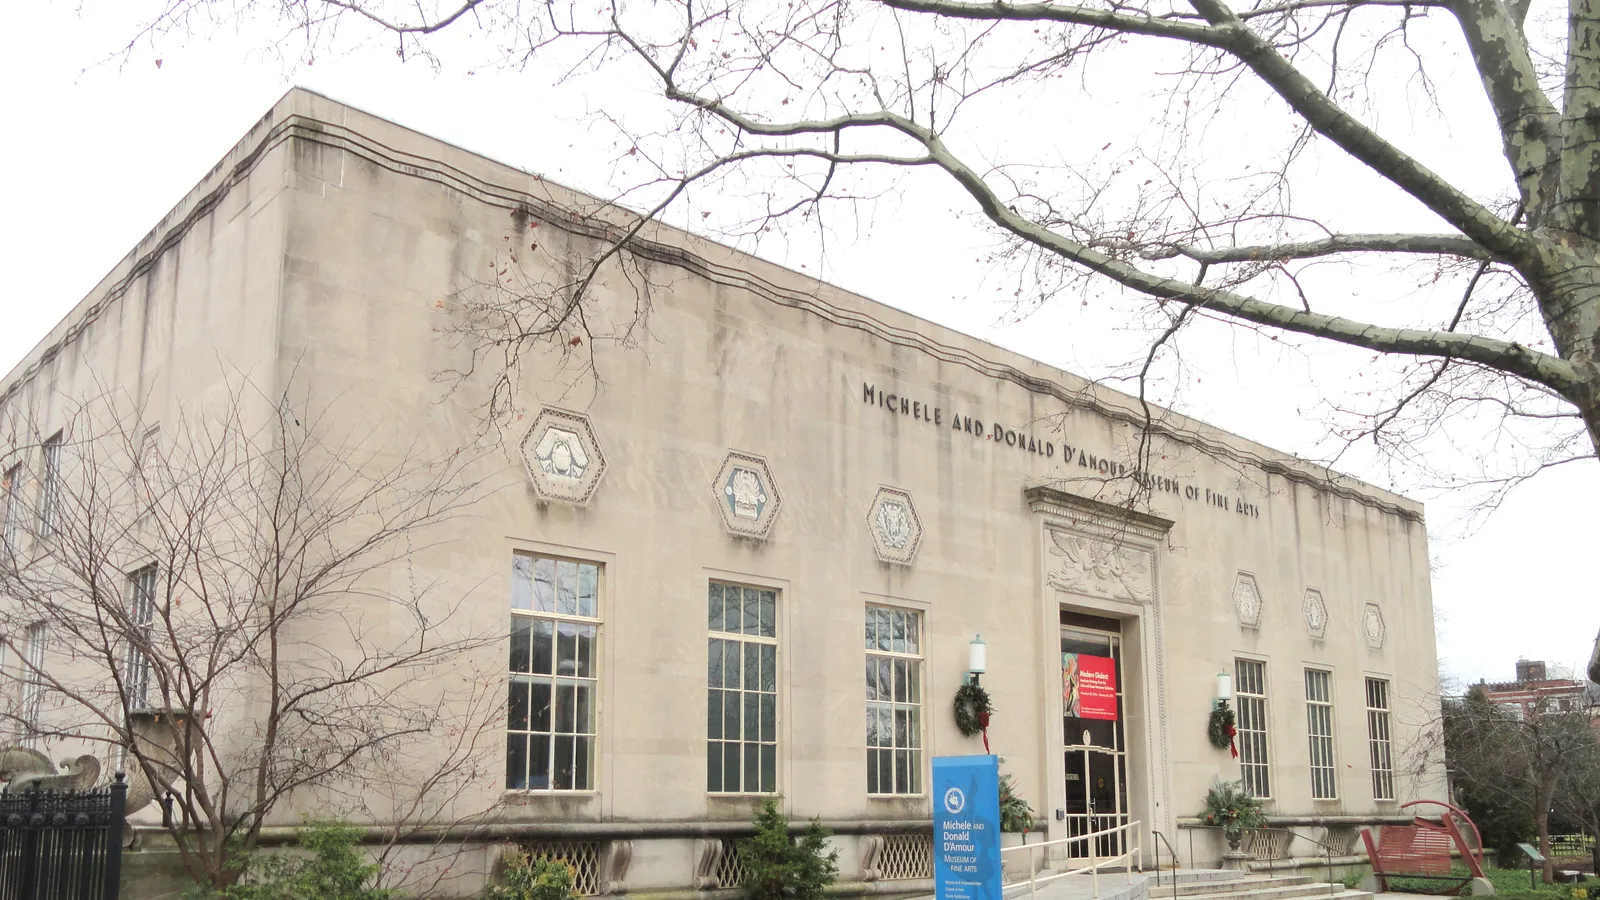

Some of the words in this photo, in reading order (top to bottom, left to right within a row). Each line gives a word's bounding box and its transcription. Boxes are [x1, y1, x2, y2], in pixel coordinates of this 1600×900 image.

[863, 382, 942, 425] MICHELE
[952, 413, 984, 437] AND
[993, 422, 1054, 458] DONALD
[1064, 444, 1125, 476] D'AMOUR
[1131, 463, 1179, 495] USEUM
[1185, 485, 1200, 501] OF
[1206, 488, 1229, 510] FINE
[1236, 497, 1260, 519] ARTS
[943, 820, 972, 830] Michele
[943, 831, 970, 841] Donald
[943, 842, 975, 852] D'Amour
[944, 854, 969, 864] MUSEUM
[969, 856, 978, 864] OF
[950, 864, 963, 872] FINE
[963, 865, 978, 873] ARTS
